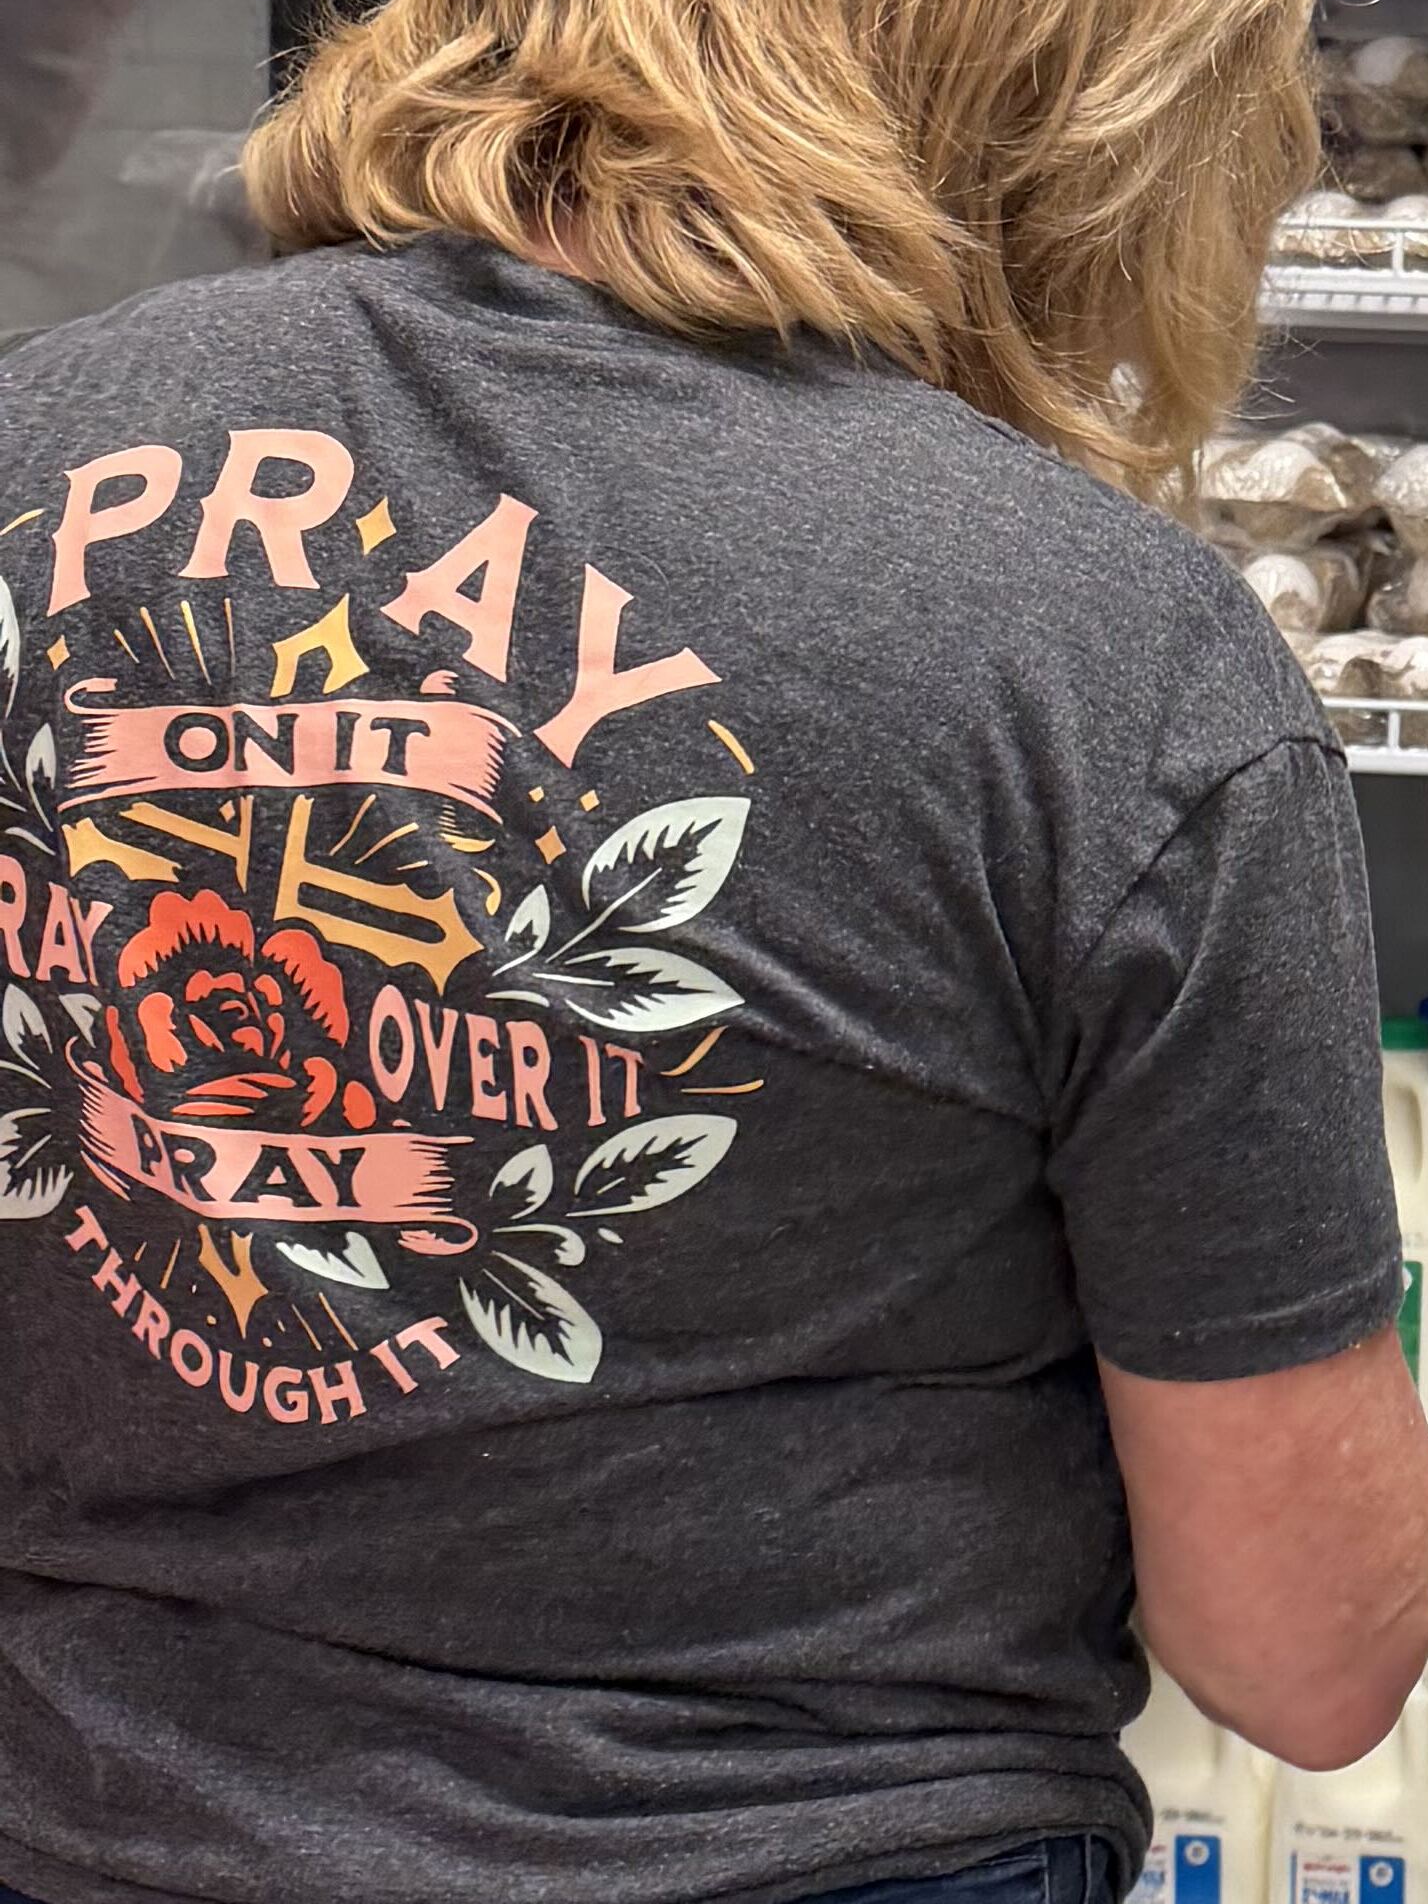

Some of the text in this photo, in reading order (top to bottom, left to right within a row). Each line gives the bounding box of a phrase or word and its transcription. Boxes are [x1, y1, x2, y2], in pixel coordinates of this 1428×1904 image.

[46, 428, 723, 770] PRAY
[163, 711, 432, 777] ON IT
[368, 986, 556, 1130] OVER
[581, 1034, 647, 1130] IT
[130, 1113, 367, 1208] PRAY
[64, 1205, 462, 1426] THROUGH IT
